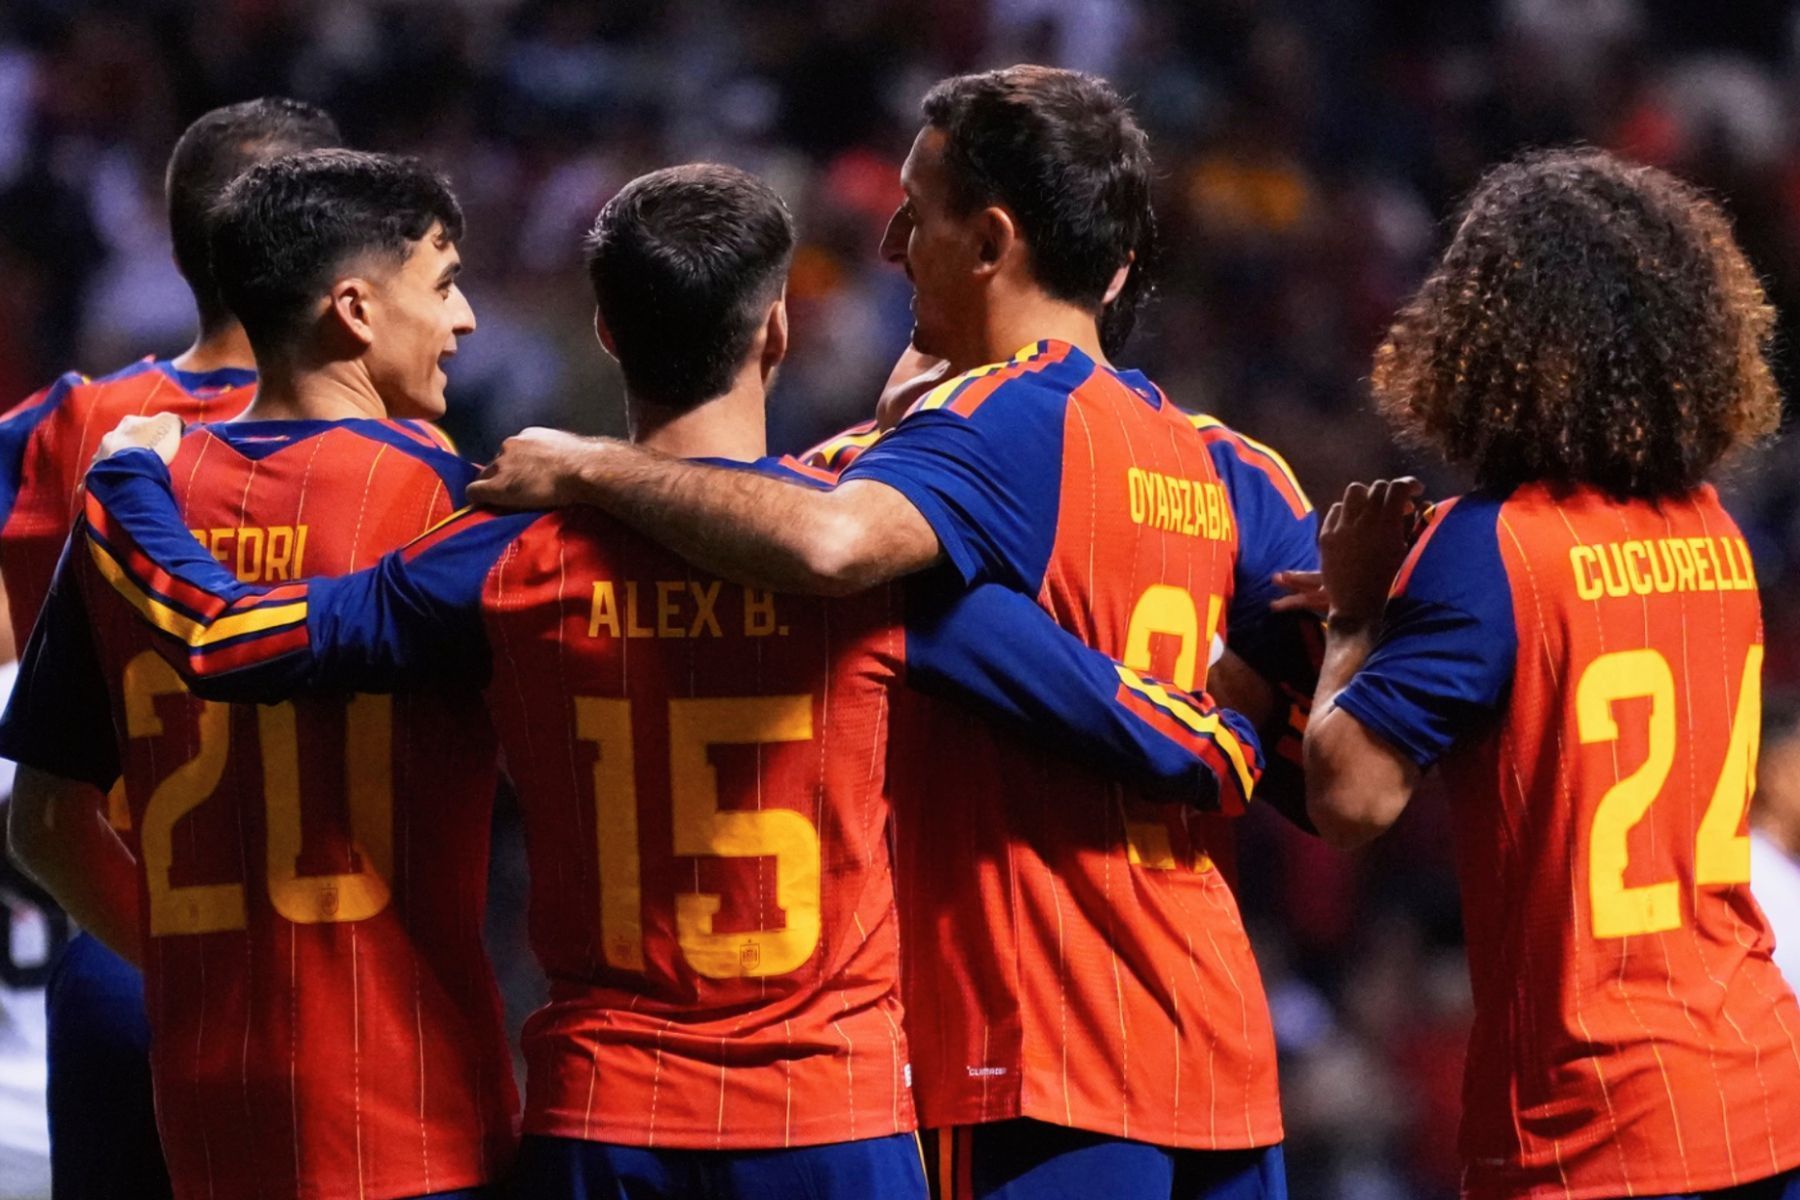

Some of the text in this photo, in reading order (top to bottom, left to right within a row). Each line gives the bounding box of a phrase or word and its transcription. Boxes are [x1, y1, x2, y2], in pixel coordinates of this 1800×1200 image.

[588, 580, 790, 638] ALEX B.
[123, 648, 393, 937] 20
[574, 694, 821, 979] 15
[1576, 645, 1764, 939] 24
